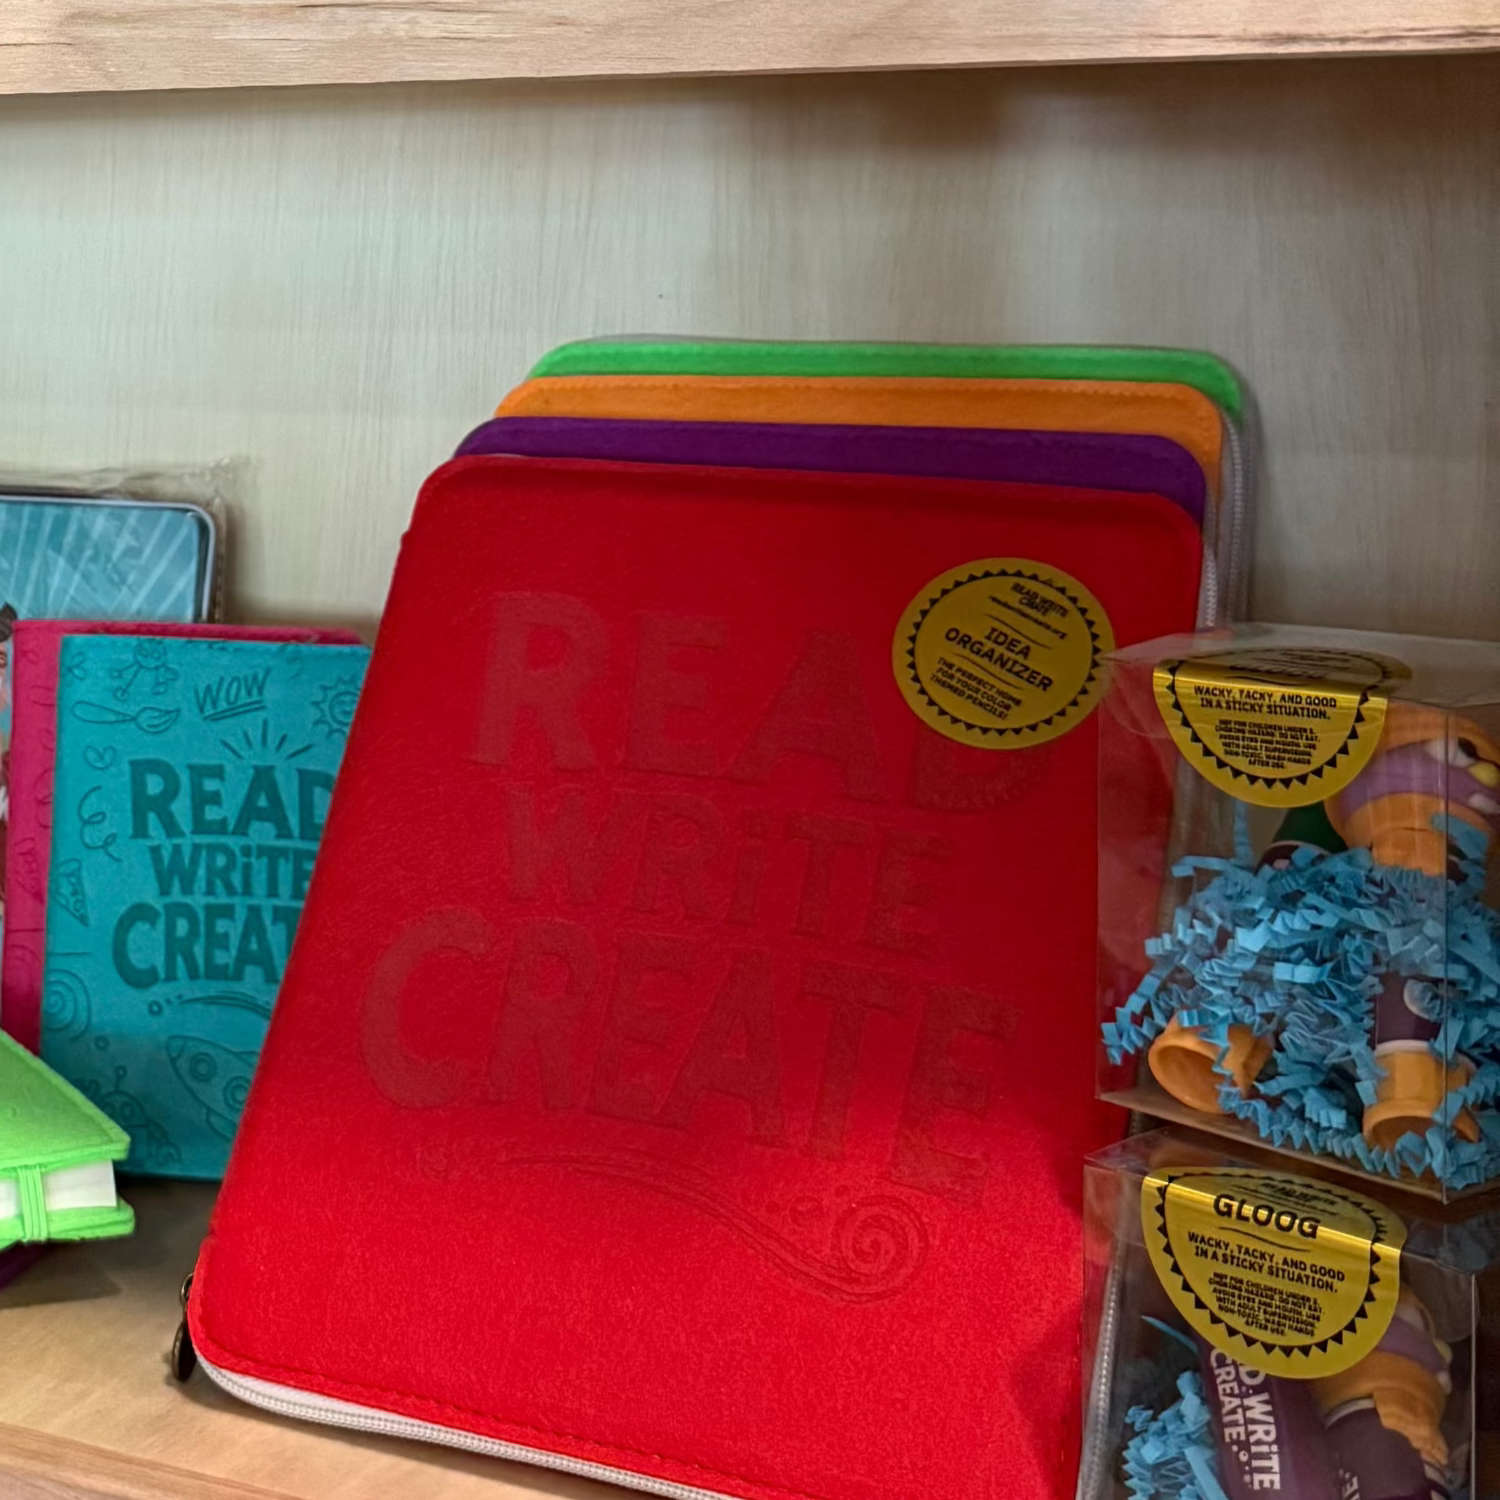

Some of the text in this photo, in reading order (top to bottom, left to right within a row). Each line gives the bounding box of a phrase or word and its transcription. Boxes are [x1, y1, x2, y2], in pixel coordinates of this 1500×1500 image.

[945, 627, 1054, 692] ORGANIZER
[984, 626, 1032, 661] IDEA
[195, 667, 271, 714] WOW
[930, 673, 966, 698] THEMED
[936, 667, 1012, 711] FOR YOUR COLOR
[938, 656, 956, 671] THE
[955, 667, 996, 692] PERFECT
[1194, 685, 1337, 708] WACKY, TACKY, AND GOOD
[1200, 698, 1331, 720] IN A STICKY SITUATION.
[128, 758, 338, 842] READ
[112, 902, 304, 989] CREAT
[360, 905, 1023, 1211] CREATE
[1213, 1193, 1321, 1239] GLOOG
[1188, 1231, 1345, 1282] WACKY, TACKY, AND GOOD
[1195, 1246, 1338, 1293] IN A STICKY SITUATION.
[1210, 1348, 1246, 1443] CREATE
